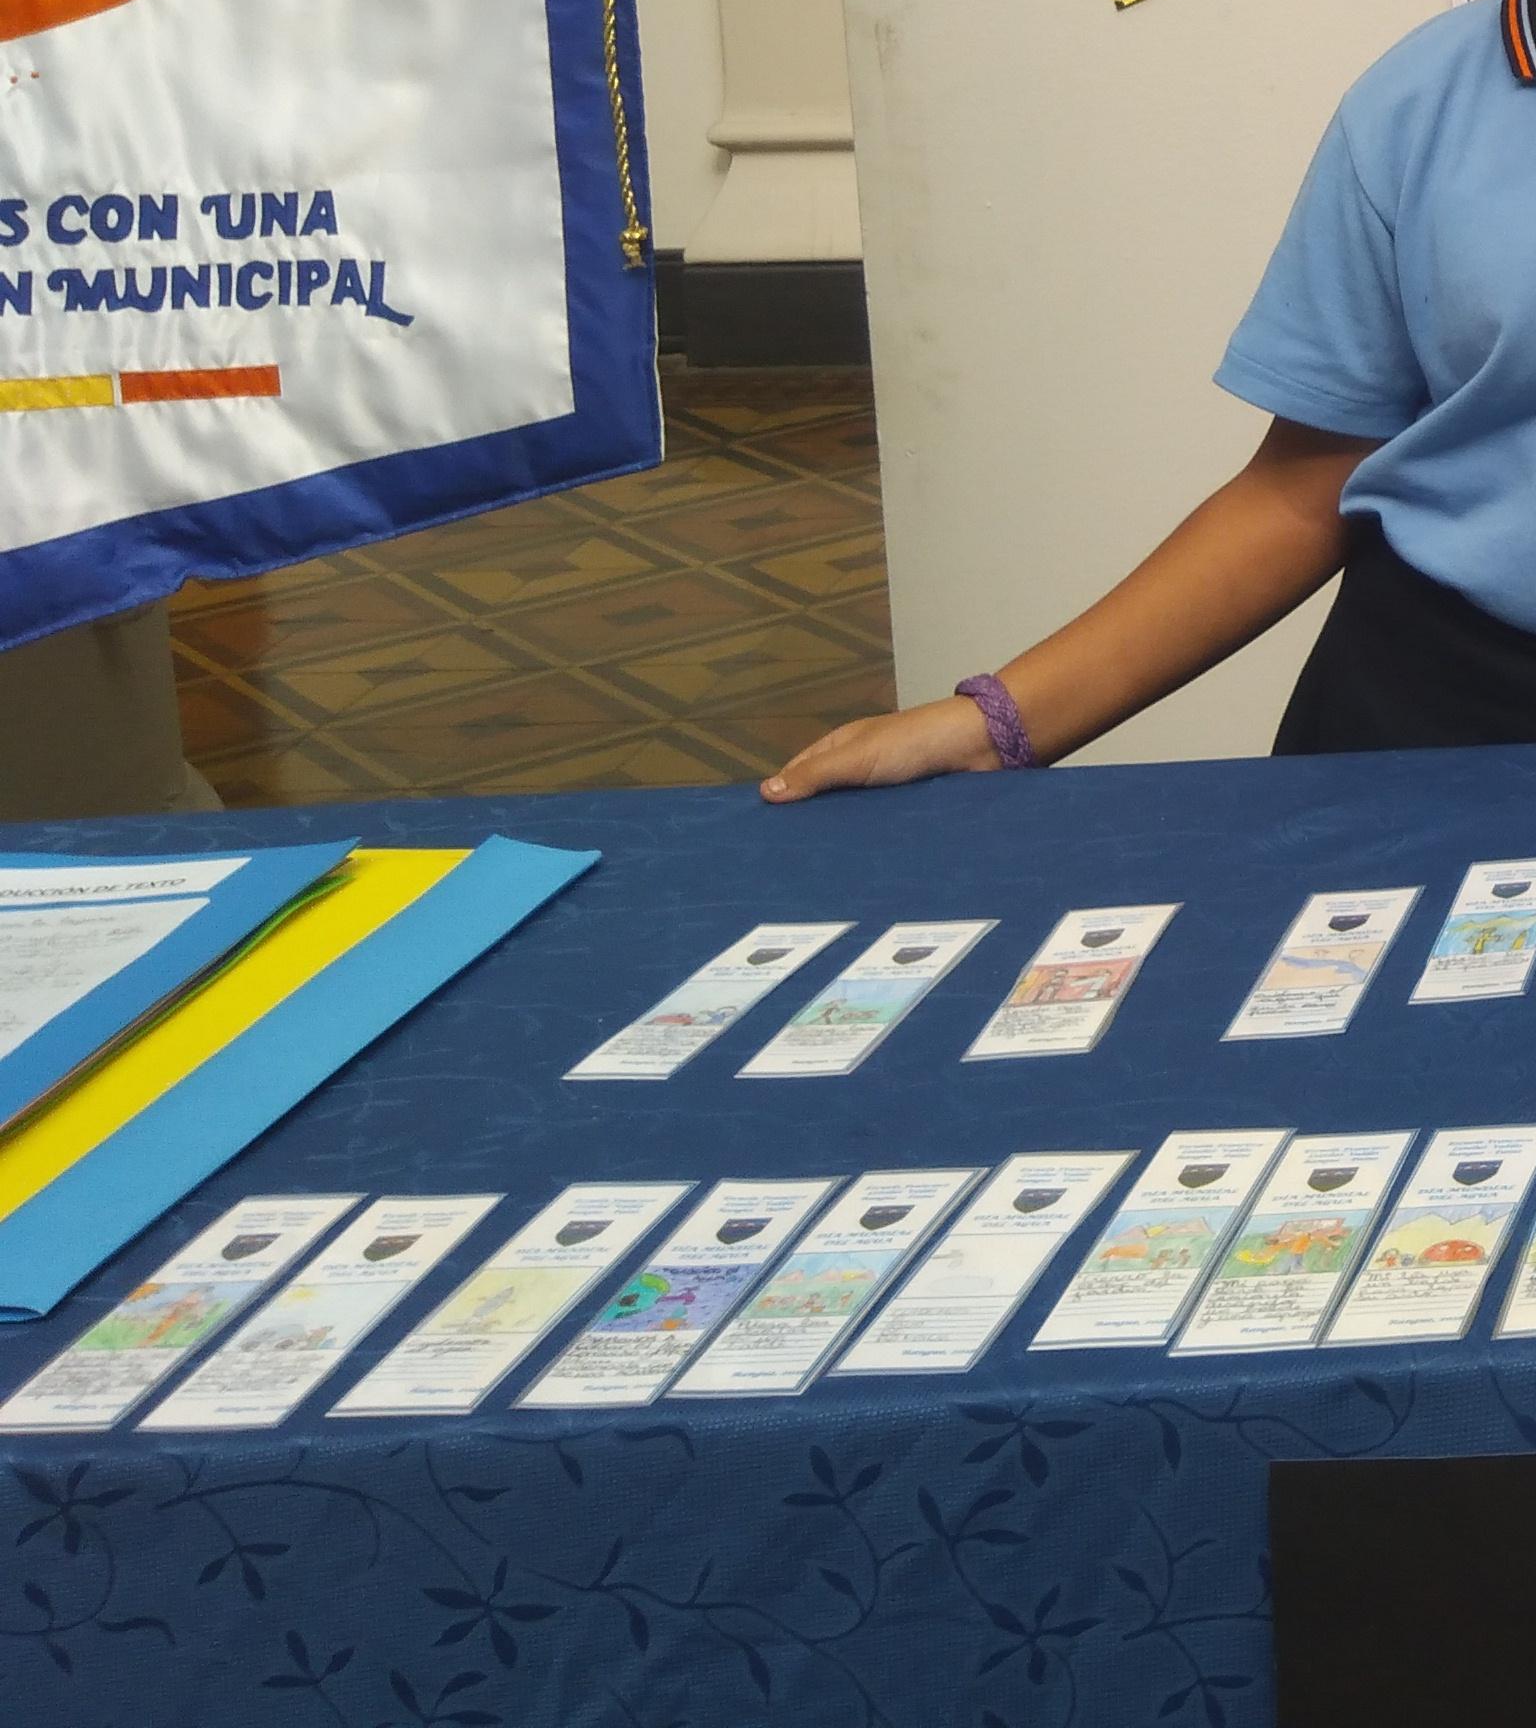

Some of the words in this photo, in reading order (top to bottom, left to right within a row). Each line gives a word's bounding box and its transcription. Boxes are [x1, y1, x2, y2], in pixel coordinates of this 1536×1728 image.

[46, 192, 180, 246] CON
[199, 189, 340, 242] UNA
[47, 258, 416, 328] MUNICIPAL
